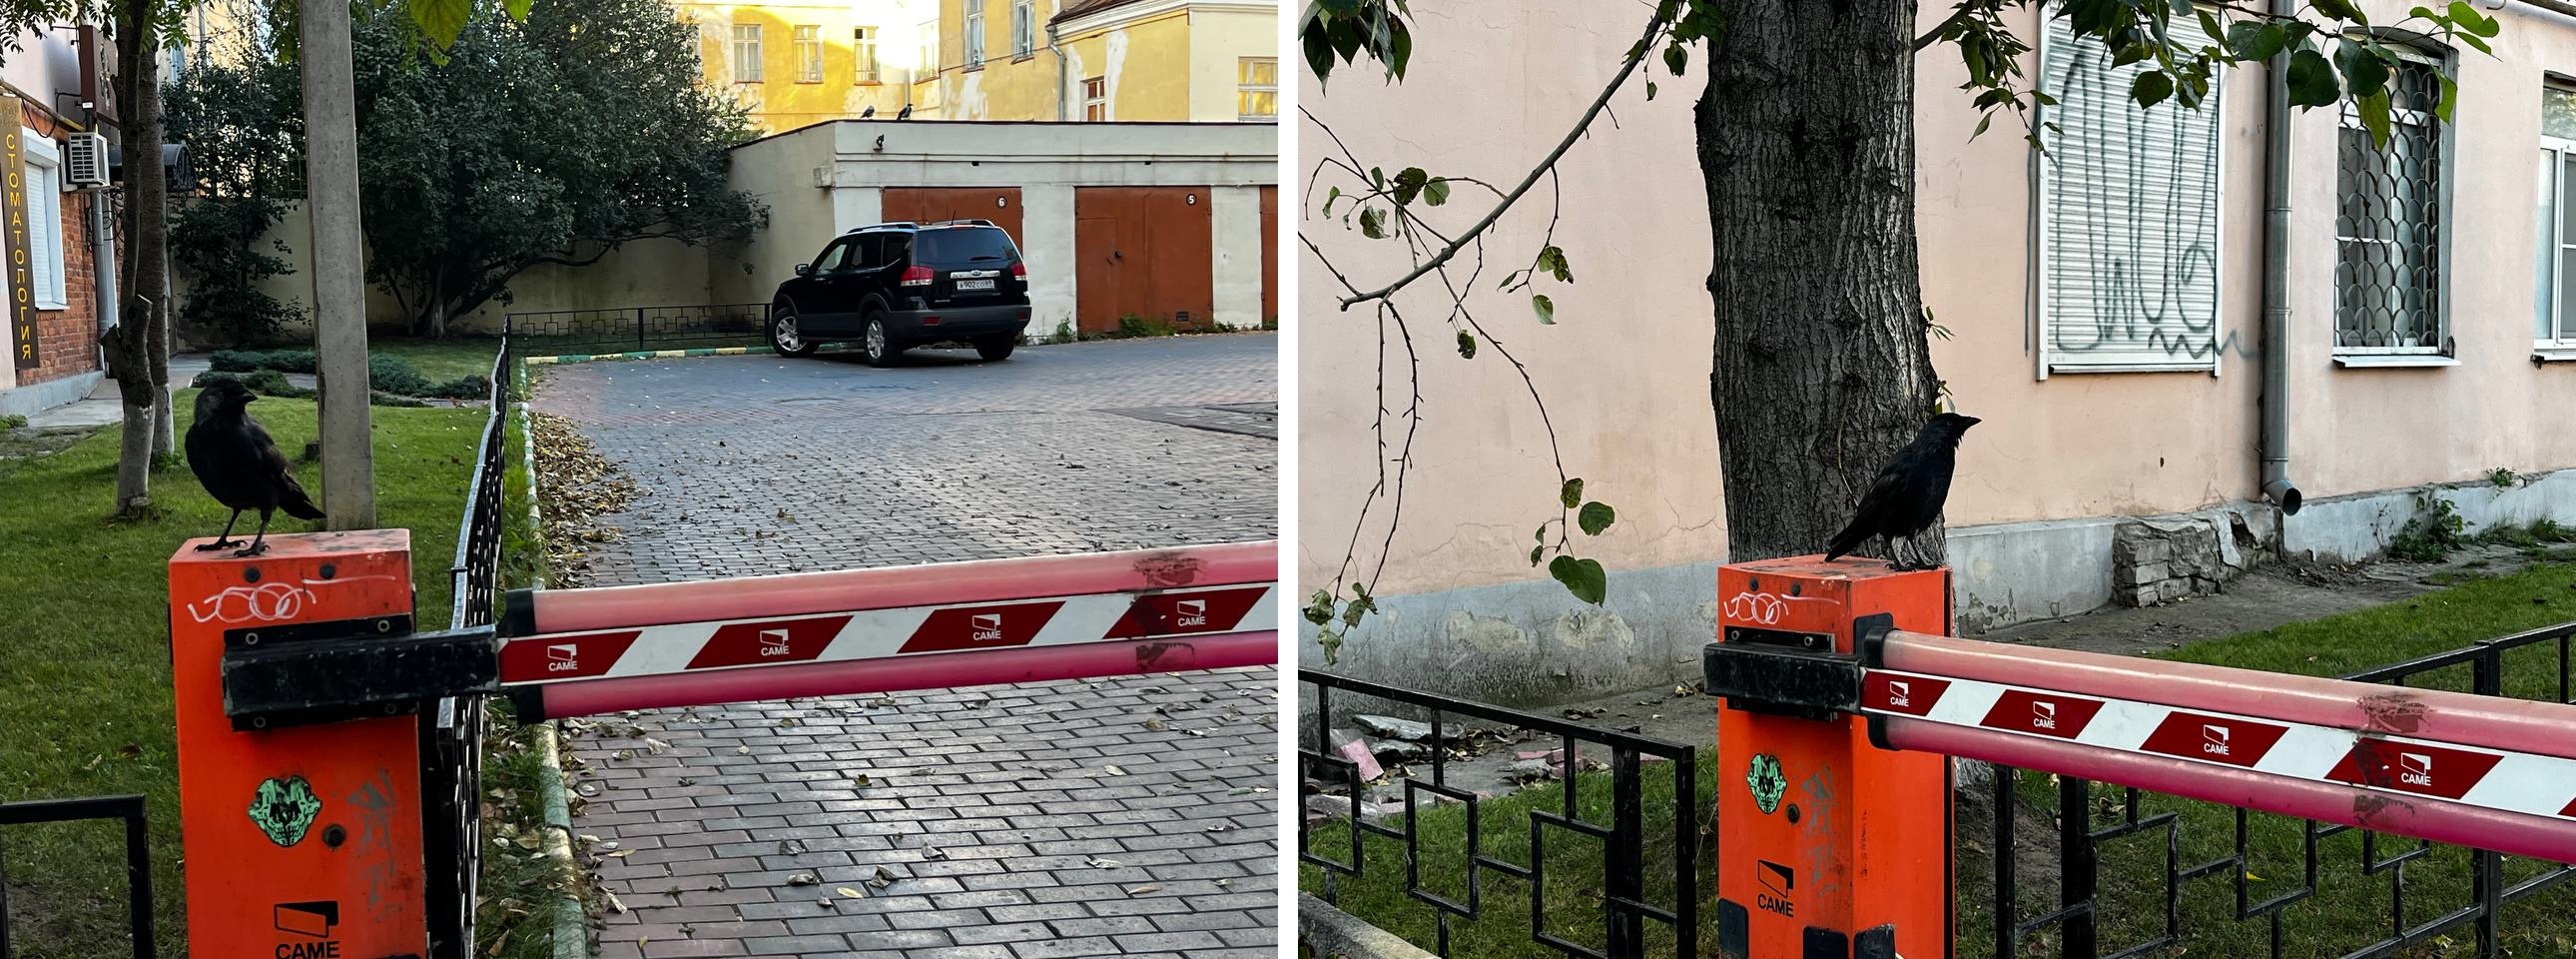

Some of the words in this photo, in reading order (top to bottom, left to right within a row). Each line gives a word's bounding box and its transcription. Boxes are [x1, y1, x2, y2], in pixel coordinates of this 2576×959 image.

[998, 197, 1005, 207] 6
[1188, 195, 1194, 205] 5
[6, 134, 31, 361] СТОМАТОЛОГИЯ
[1177, 616, 1206, 627] CAME
[972, 630, 1001, 641] CAME
[760, 645, 790, 656] CAME
[548, 660, 578, 671] CAME
[1890, 696, 1909, 707] CAME
[2033, 717, 2056, 730] CAME
[2204, 743, 2230, 756] CAME
[2401, 772, 2431, 787] CAME
[1757, 893, 1794, 918] CAME
[275, 940, 340, 959] CAME
